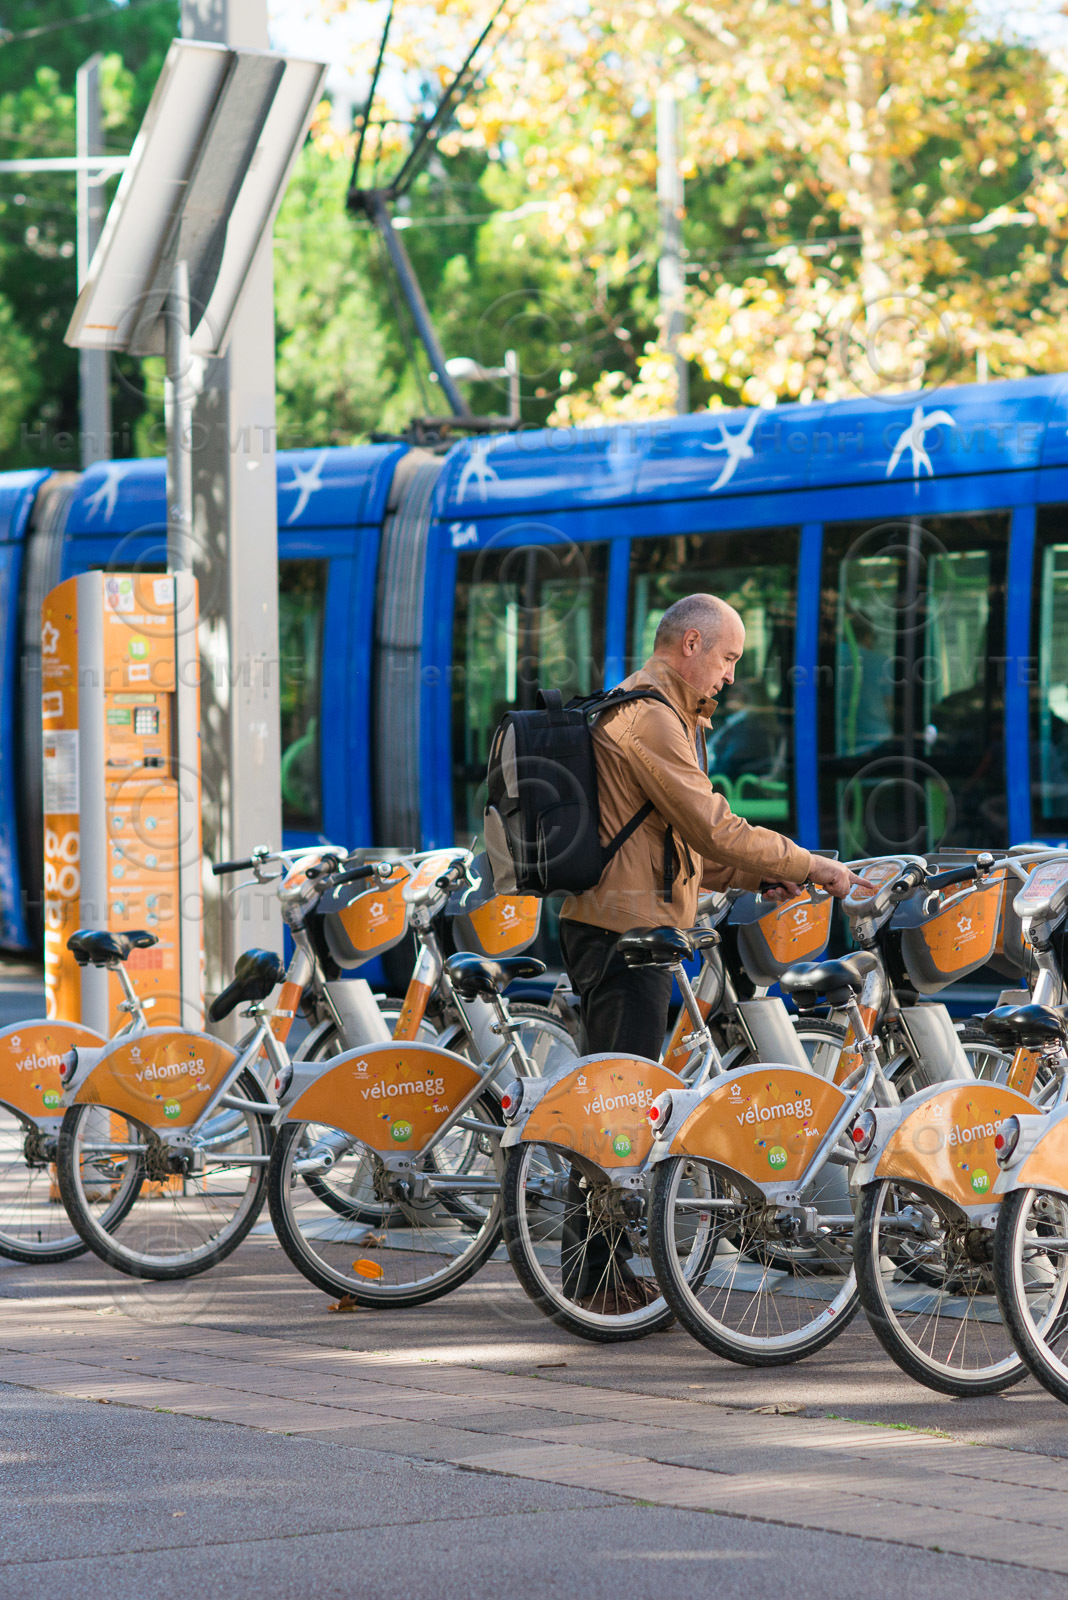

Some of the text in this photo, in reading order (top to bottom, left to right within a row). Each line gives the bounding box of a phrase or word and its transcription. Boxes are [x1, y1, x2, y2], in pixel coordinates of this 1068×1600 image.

[136, 1058, 206, 1082] vélomagg
[361, 1078, 445, 1101] vélomagg
[45, 1095, 59, 1104] 672
[583, 1088, 654, 1115] vélomagg
[164, 1104, 180, 1115] 209
[736, 1098, 813, 1126] vélomagg
[393, 1126, 410, 1137] 659
[615, 1141, 629, 1151] 473
[769, 1154, 786, 1164] 055
[973, 1176, 987, 1188] 497
